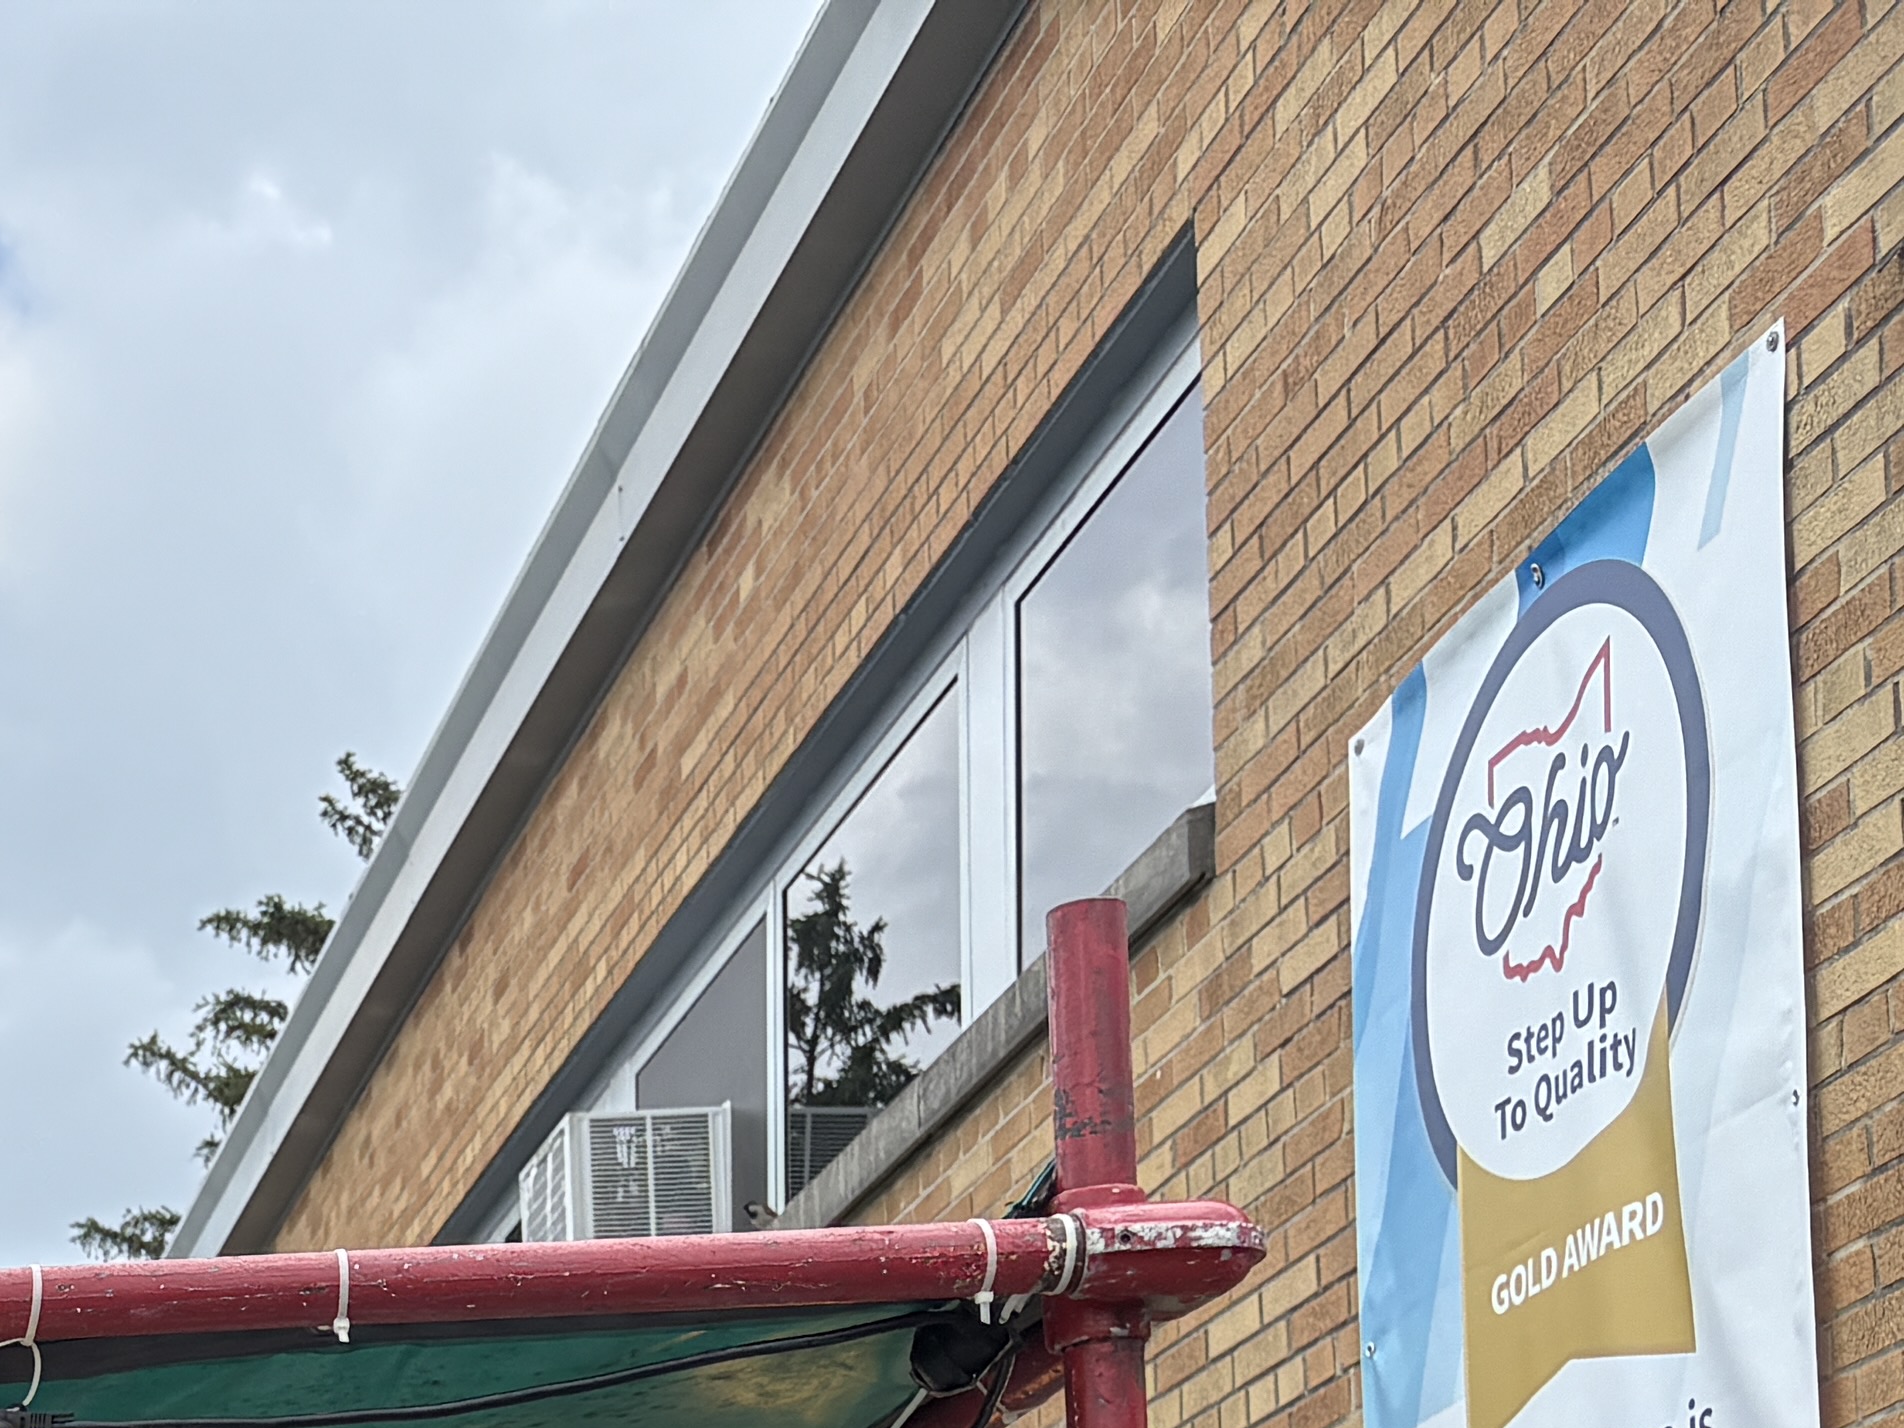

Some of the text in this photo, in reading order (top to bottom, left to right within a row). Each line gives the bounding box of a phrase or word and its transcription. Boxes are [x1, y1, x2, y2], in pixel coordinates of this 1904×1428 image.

[1456, 730, 1630, 956] Ohio
[1494, 1027, 1636, 1140] To Quality
[1507, 980, 1617, 1074] Step Up
[1490, 1192, 1664, 1317] GOLD AWARD
